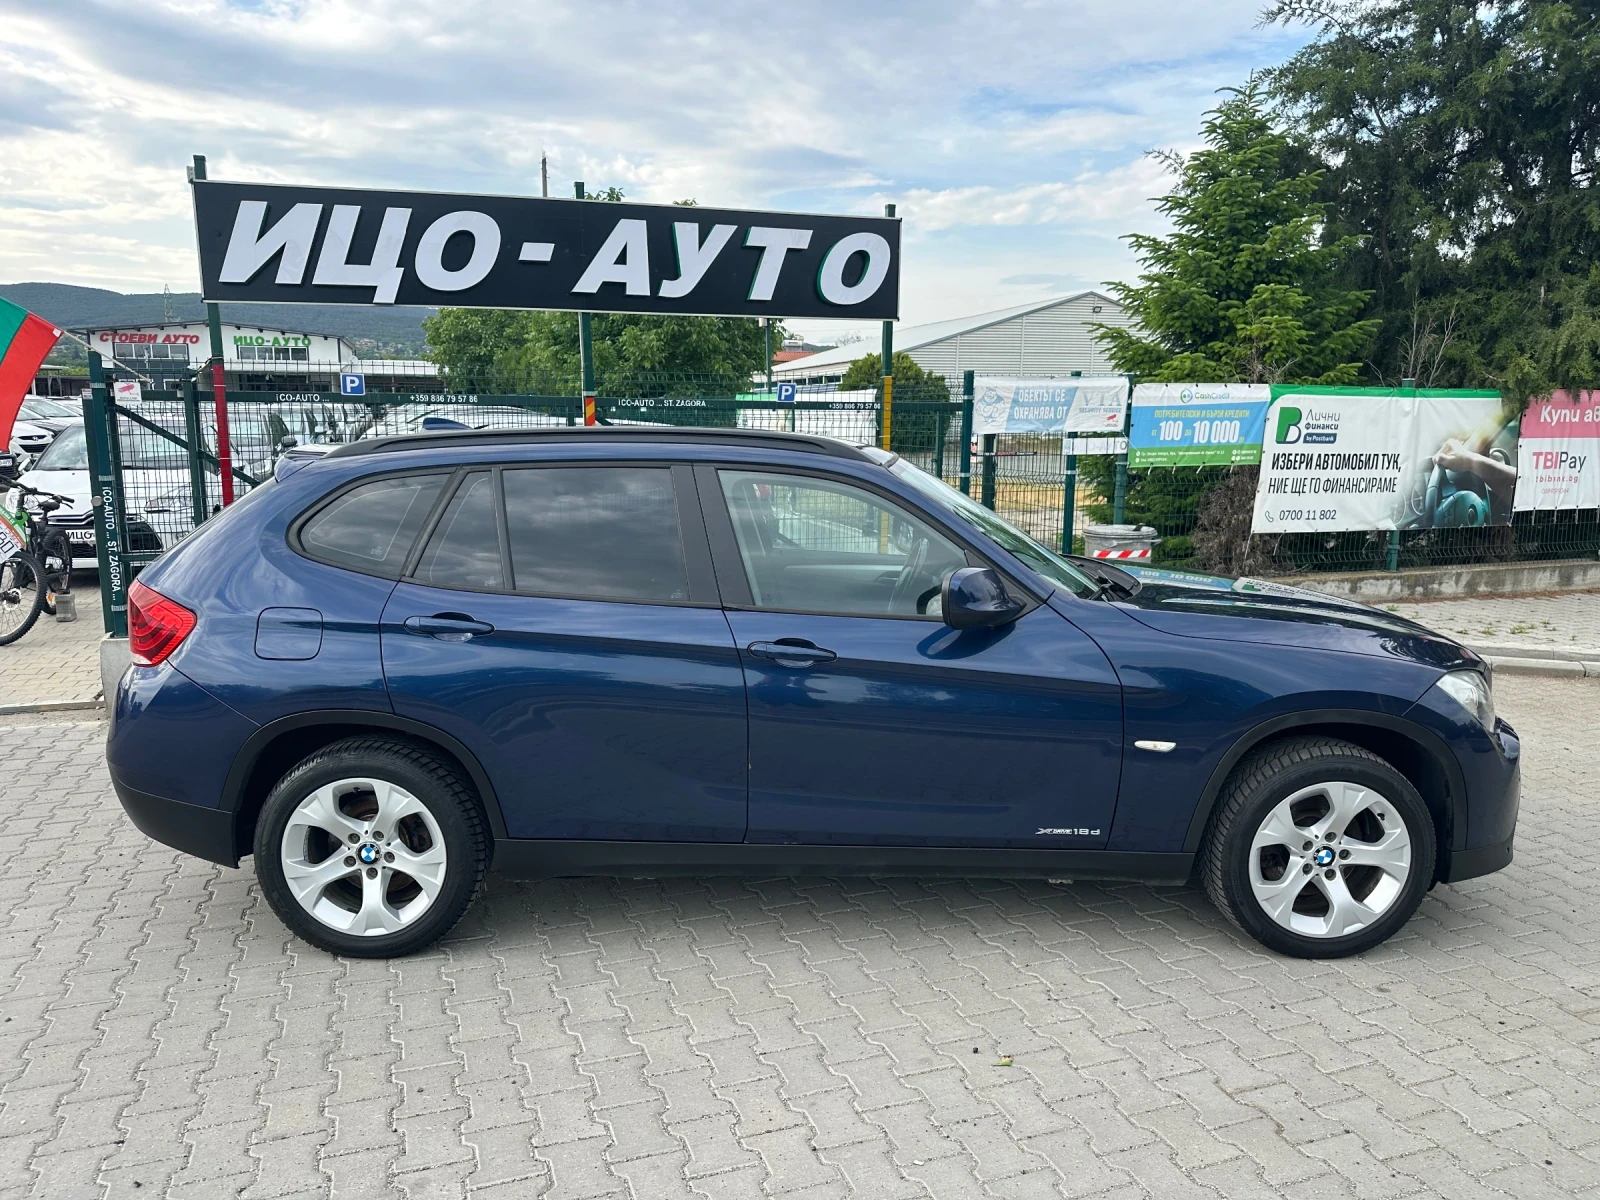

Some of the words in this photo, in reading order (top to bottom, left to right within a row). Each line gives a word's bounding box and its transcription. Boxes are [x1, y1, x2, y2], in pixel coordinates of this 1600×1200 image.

[100, 332, 158, 343] СТОЕВИ
[161, 332, 200, 344] АУТО
[233, 335, 312, 347] ИЦО-АУТО
[409, 394, 429, 402] +359
[446, 395, 456, 403] 79
[457, 395, 467, 403] 57
[1054, 389, 1066, 401] СЕ
[1194, 392, 1230, 400] CashCredit
[675, 399, 707, 407] ZAGORA
[1013, 406, 1055, 420] ОХРАНЯВА
[1056, 406, 1068, 419] ОТ
[1305, 408, 1341, 422] Лични
[1159, 420, 1183, 441] 100
[1304, 422, 1339, 430] Финанси
[1271, 453, 1315, 470] ИЗБЕРИ
[1315, 453, 1380, 470] АВТОМОБИЛ
[1381, 453, 1402, 473] ТУК,
[1268, 477, 1289, 493] НИЕ
[1290, 477, 1308, 496] ЩЕ
[1309, 477, 1321, 493] ГО
[1322, 477, 1398, 493] ФИНАНСИРАМЕ
[1279, 509, 1303, 520] 0700
[1305, 509, 1317, 520] 11
[1319, 509, 1337, 520] 802
[109, 555, 121, 592] ZAGORA
